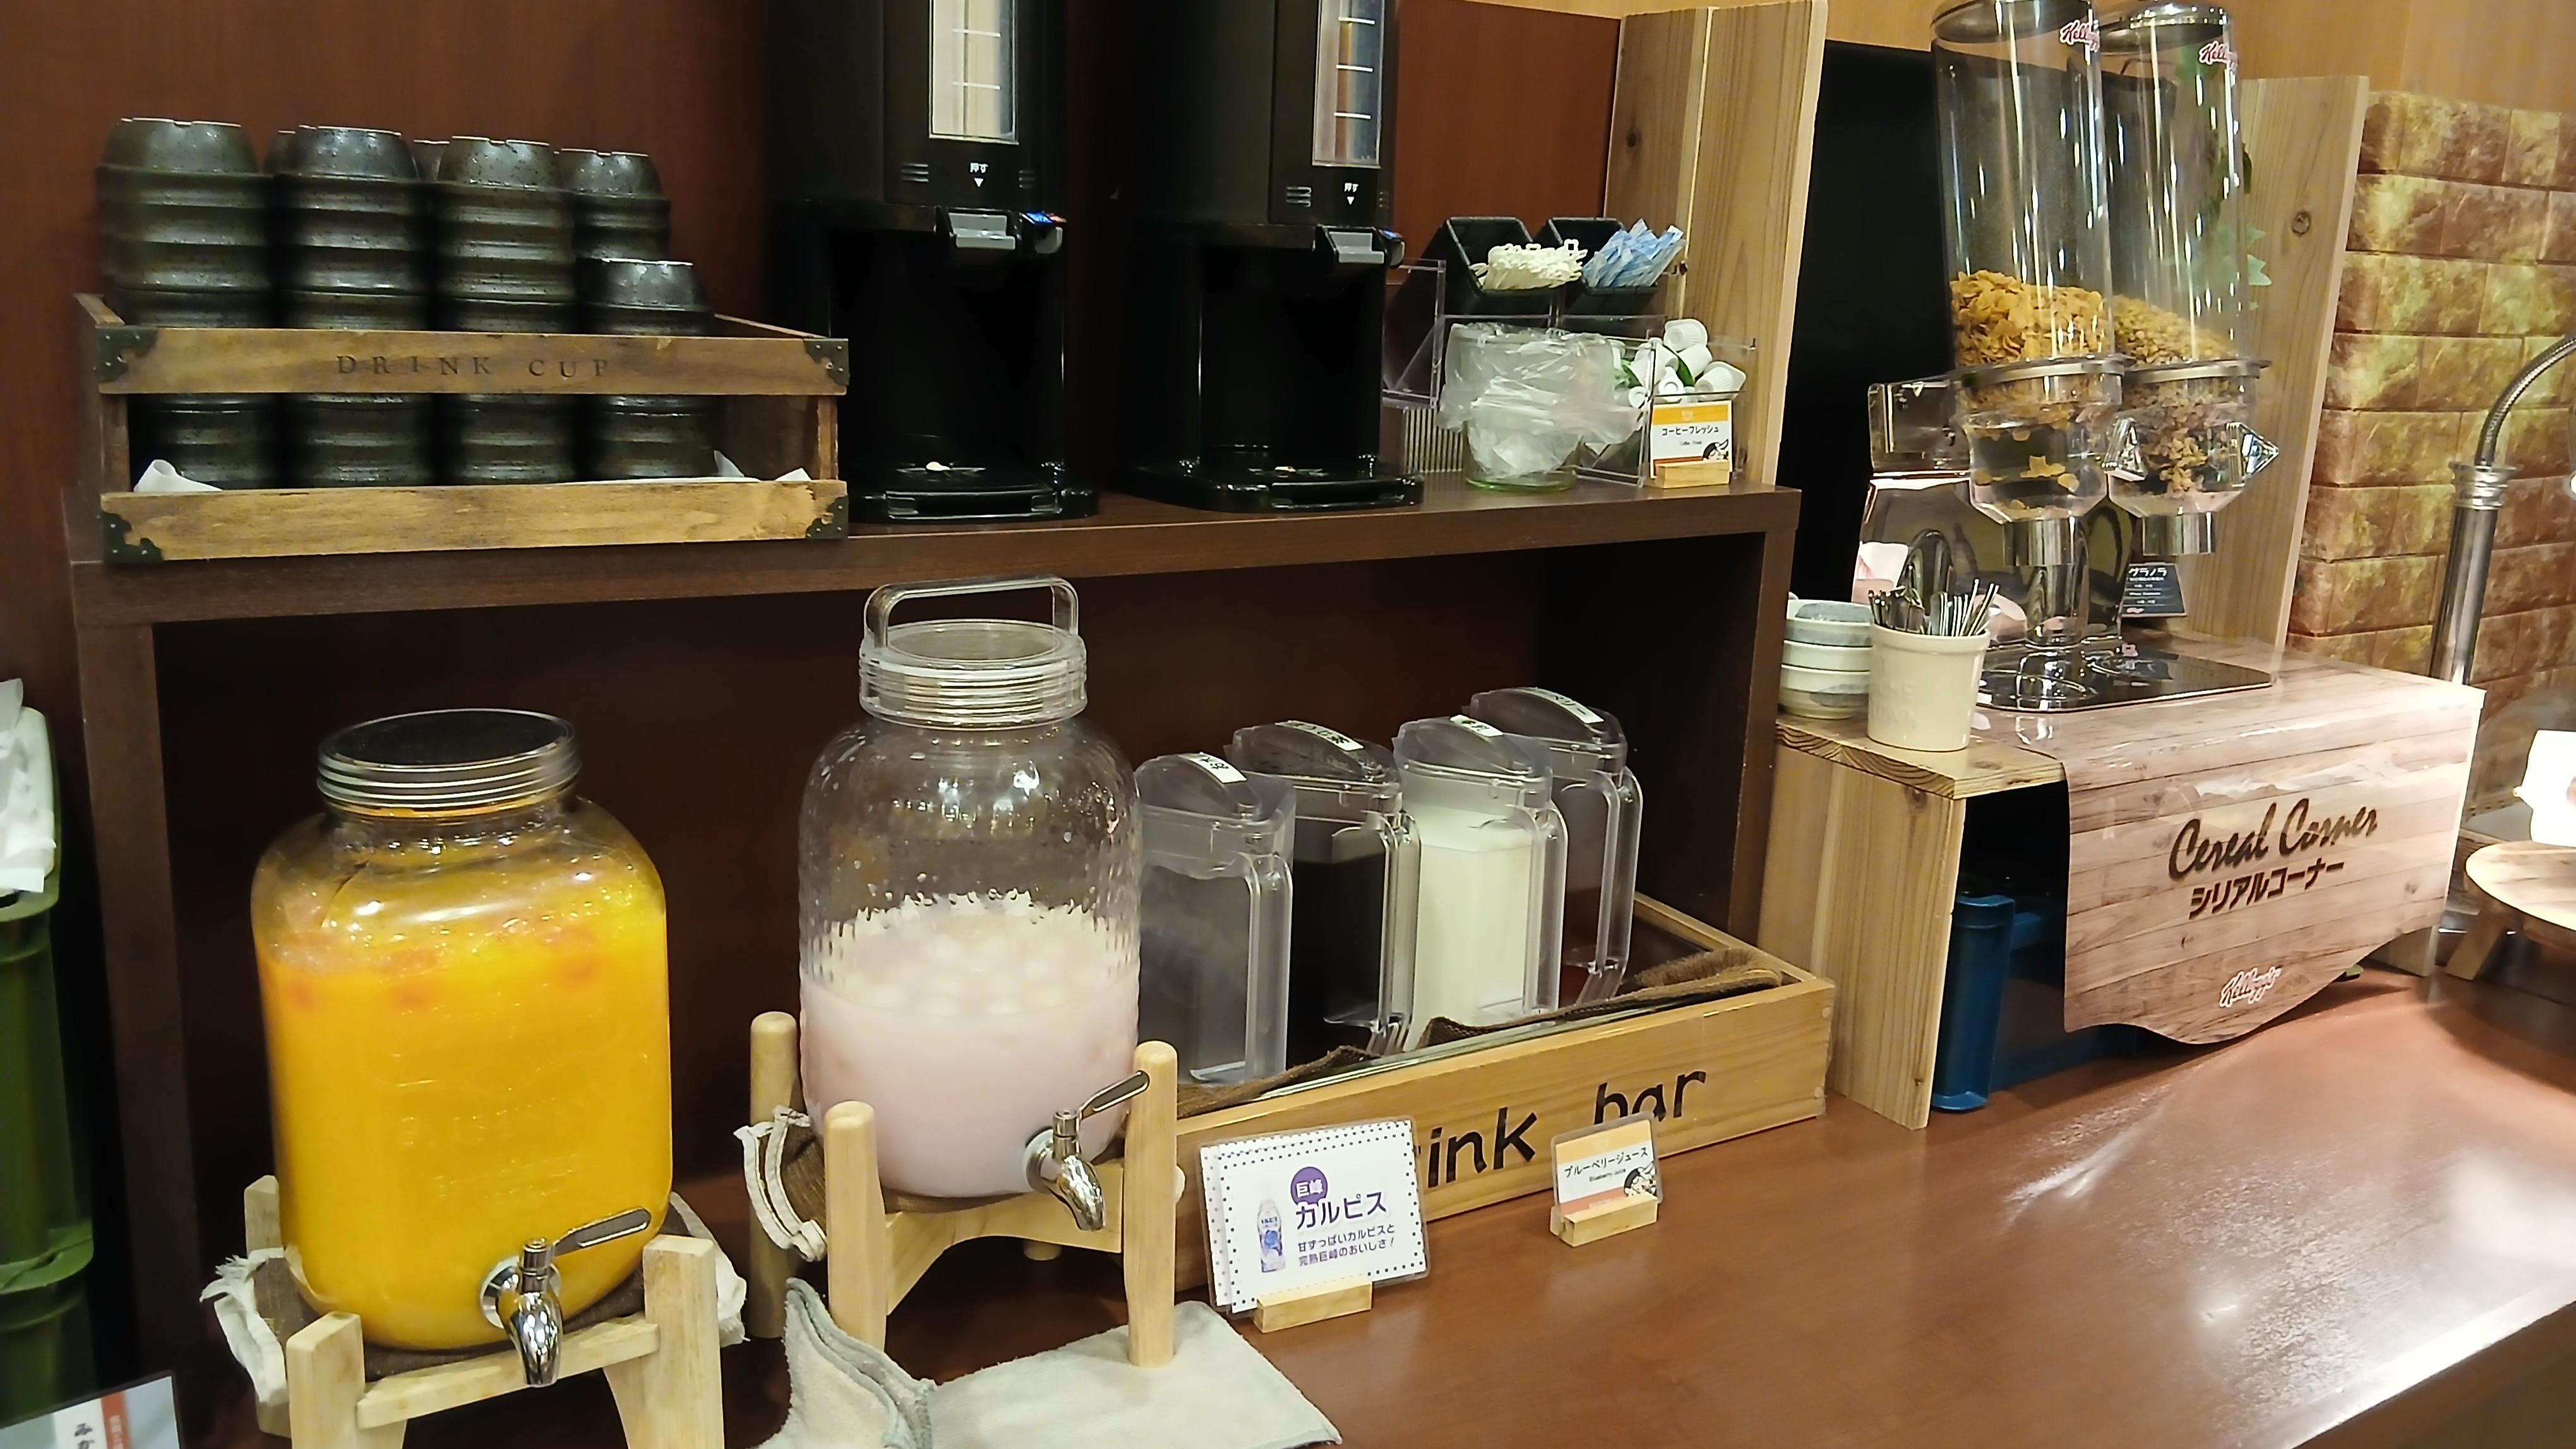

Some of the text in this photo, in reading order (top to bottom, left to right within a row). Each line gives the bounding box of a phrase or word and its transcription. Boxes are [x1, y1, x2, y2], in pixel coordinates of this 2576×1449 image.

[337, 355, 609, 378] DRINK CUP
[1662, 425, 1719, 436] コーヒーフレッシュ
[2167, 797, 2378, 880] Cereal Corner
[2188, 857, 2345, 920] シリアルコーナー
[1418, 1071, 1706, 1188] ink bar
[1564, 1147, 1648, 1179] ブルーベリージュース
[1296, 1191, 1387, 1230] カルピス
